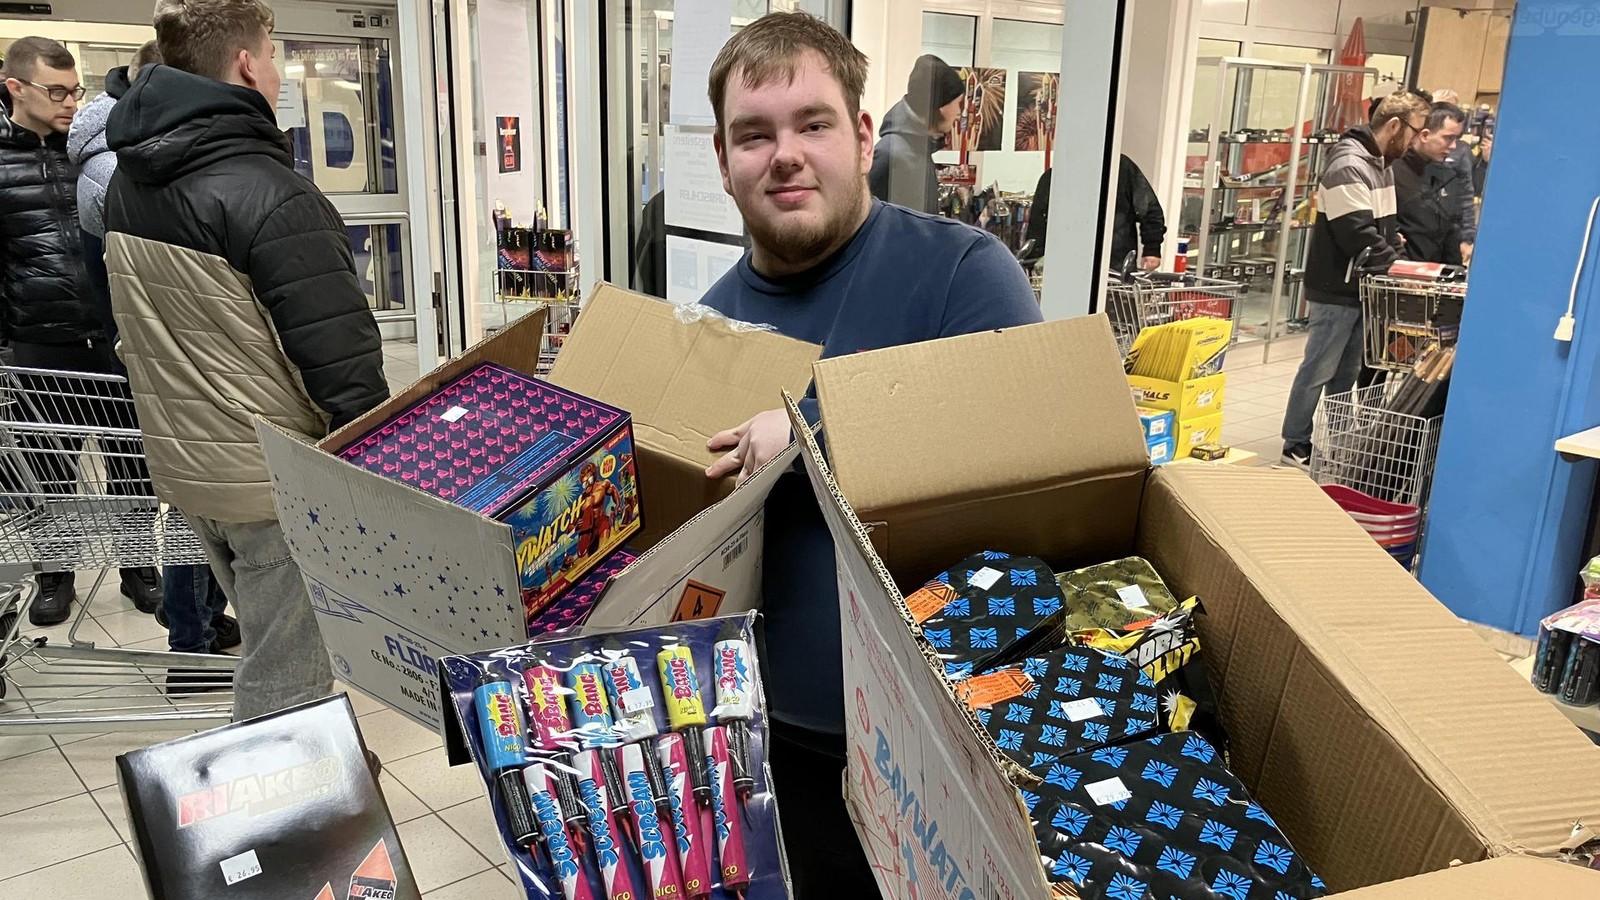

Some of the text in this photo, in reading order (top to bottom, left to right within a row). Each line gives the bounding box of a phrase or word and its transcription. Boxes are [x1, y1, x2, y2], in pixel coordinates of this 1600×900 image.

[301, 50, 324, 61] befinden
[346, 48, 359, 60] Par
[1142, 390, 1170, 400] HALS
[516, 495, 587, 575] YWATCH
[371, 649, 382, 662] CE
[384, 635, 439, 678] FLOR
[400, 685, 437, 712] MADE IN
[540, 676, 562, 720] BANG
[580, 673, 604, 718] BANG
[609, 665, 631, 710] ANG
[668, 657, 693, 700] BANG
[495, 693, 518, 738] BANG
[504, 744, 522, 752] NICO
[531, 790, 580, 881] SCREAM
[578, 778, 620, 869] SCREAM
[628, 771, 666, 860] SCREAM
[236, 864, 261, 880] 26.95
[654, 883, 677, 898] NICO
